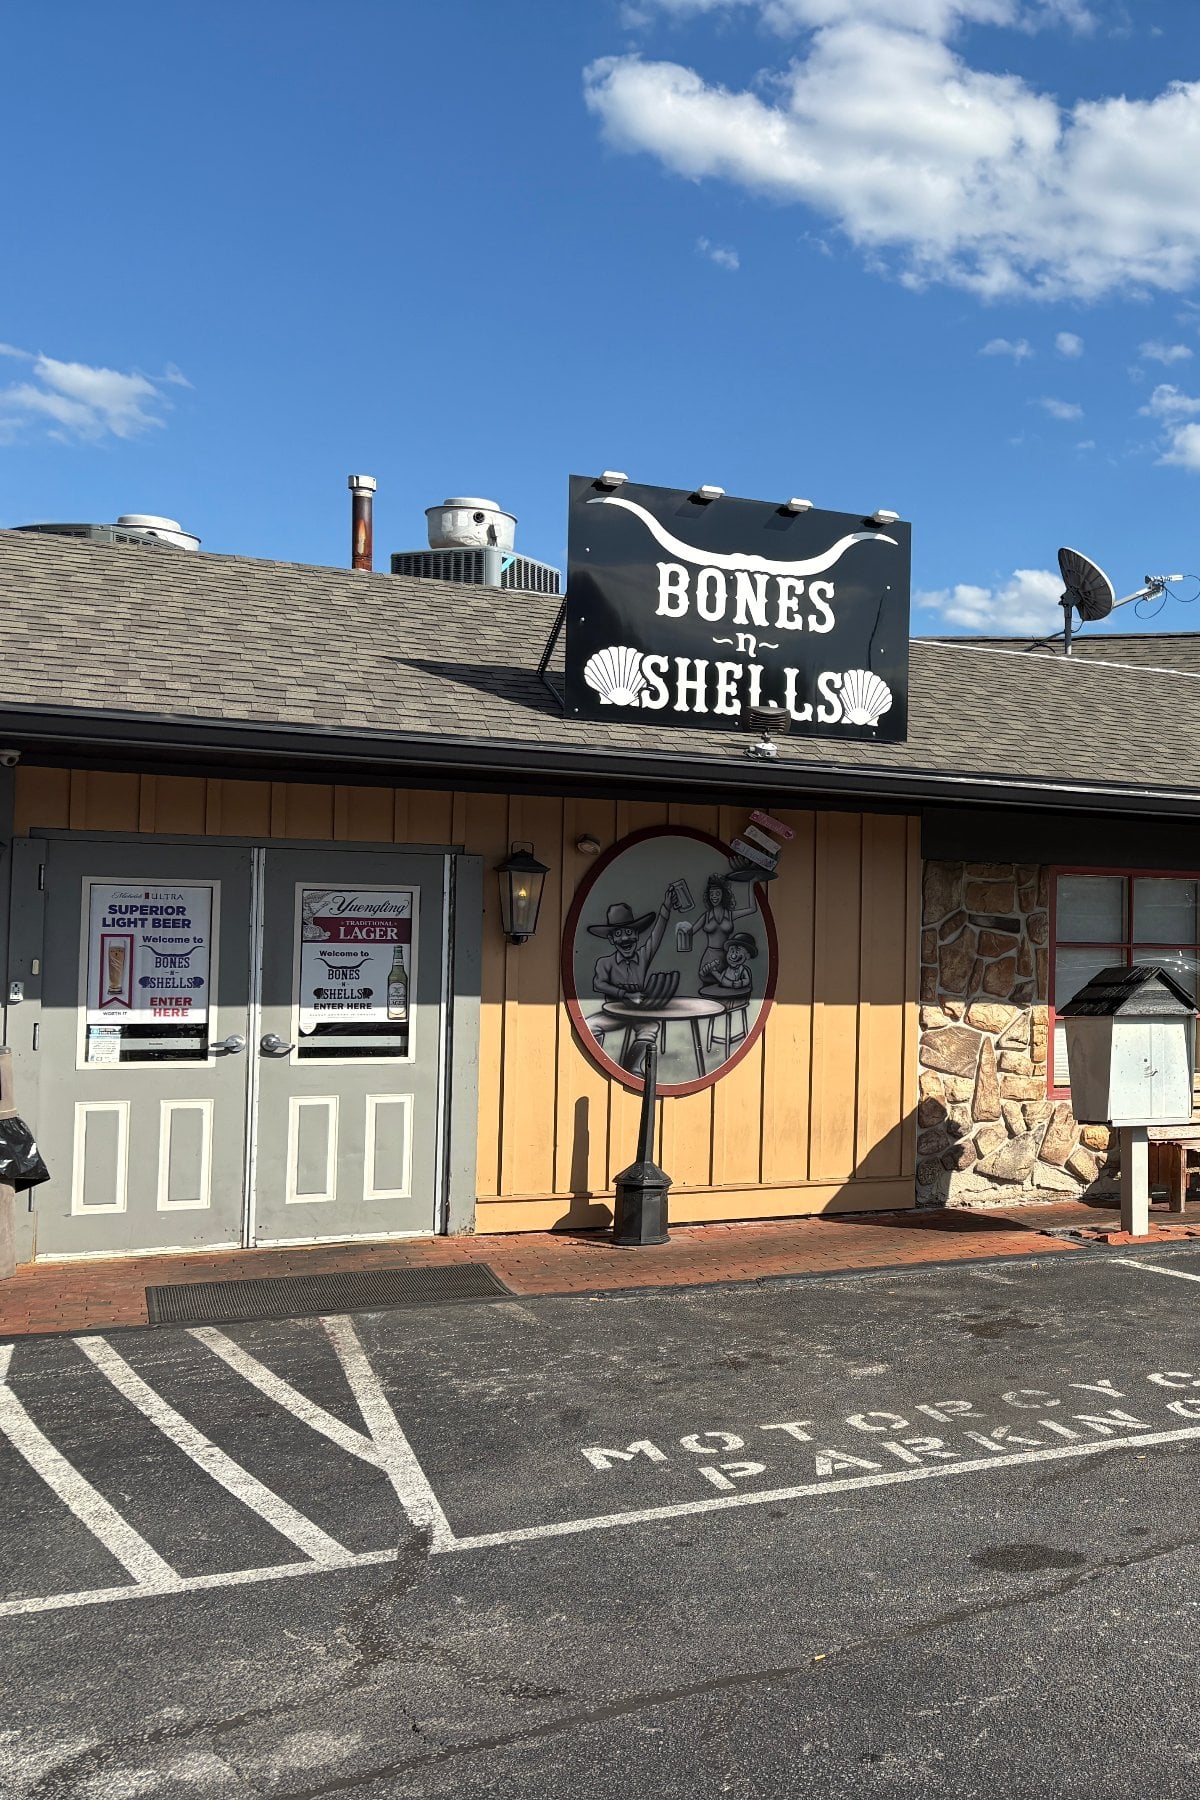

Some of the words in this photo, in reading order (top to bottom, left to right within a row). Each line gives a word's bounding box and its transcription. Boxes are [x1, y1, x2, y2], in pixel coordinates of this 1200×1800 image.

[655, 561, 836, 634] BONES
[640, 654, 845, 725] SHELLS
[151, 893, 184, 901] ULTRA
[108, 904, 187, 916] SUPERIOR
[328, 895, 410, 917] Yuengling
[102, 917, 148, 929] LIGHT
[151, 917, 192, 929] BEER
[339, 926, 398, 940] LAGER
[142, 935, 190, 943] Welcome
[193, 936, 204, 944] to
[155, 956, 190, 969] BONES
[327, 968, 360, 980] BONES
[150, 977, 193, 989] SHELLS
[323, 988, 363, 1000] SHELLS
[150, 997, 192, 1007] ENTER
[313, 1002, 344, 1010] ENTER
[346, 1002, 372, 1010] HERE
[153, 1008, 189, 1017] HERE
